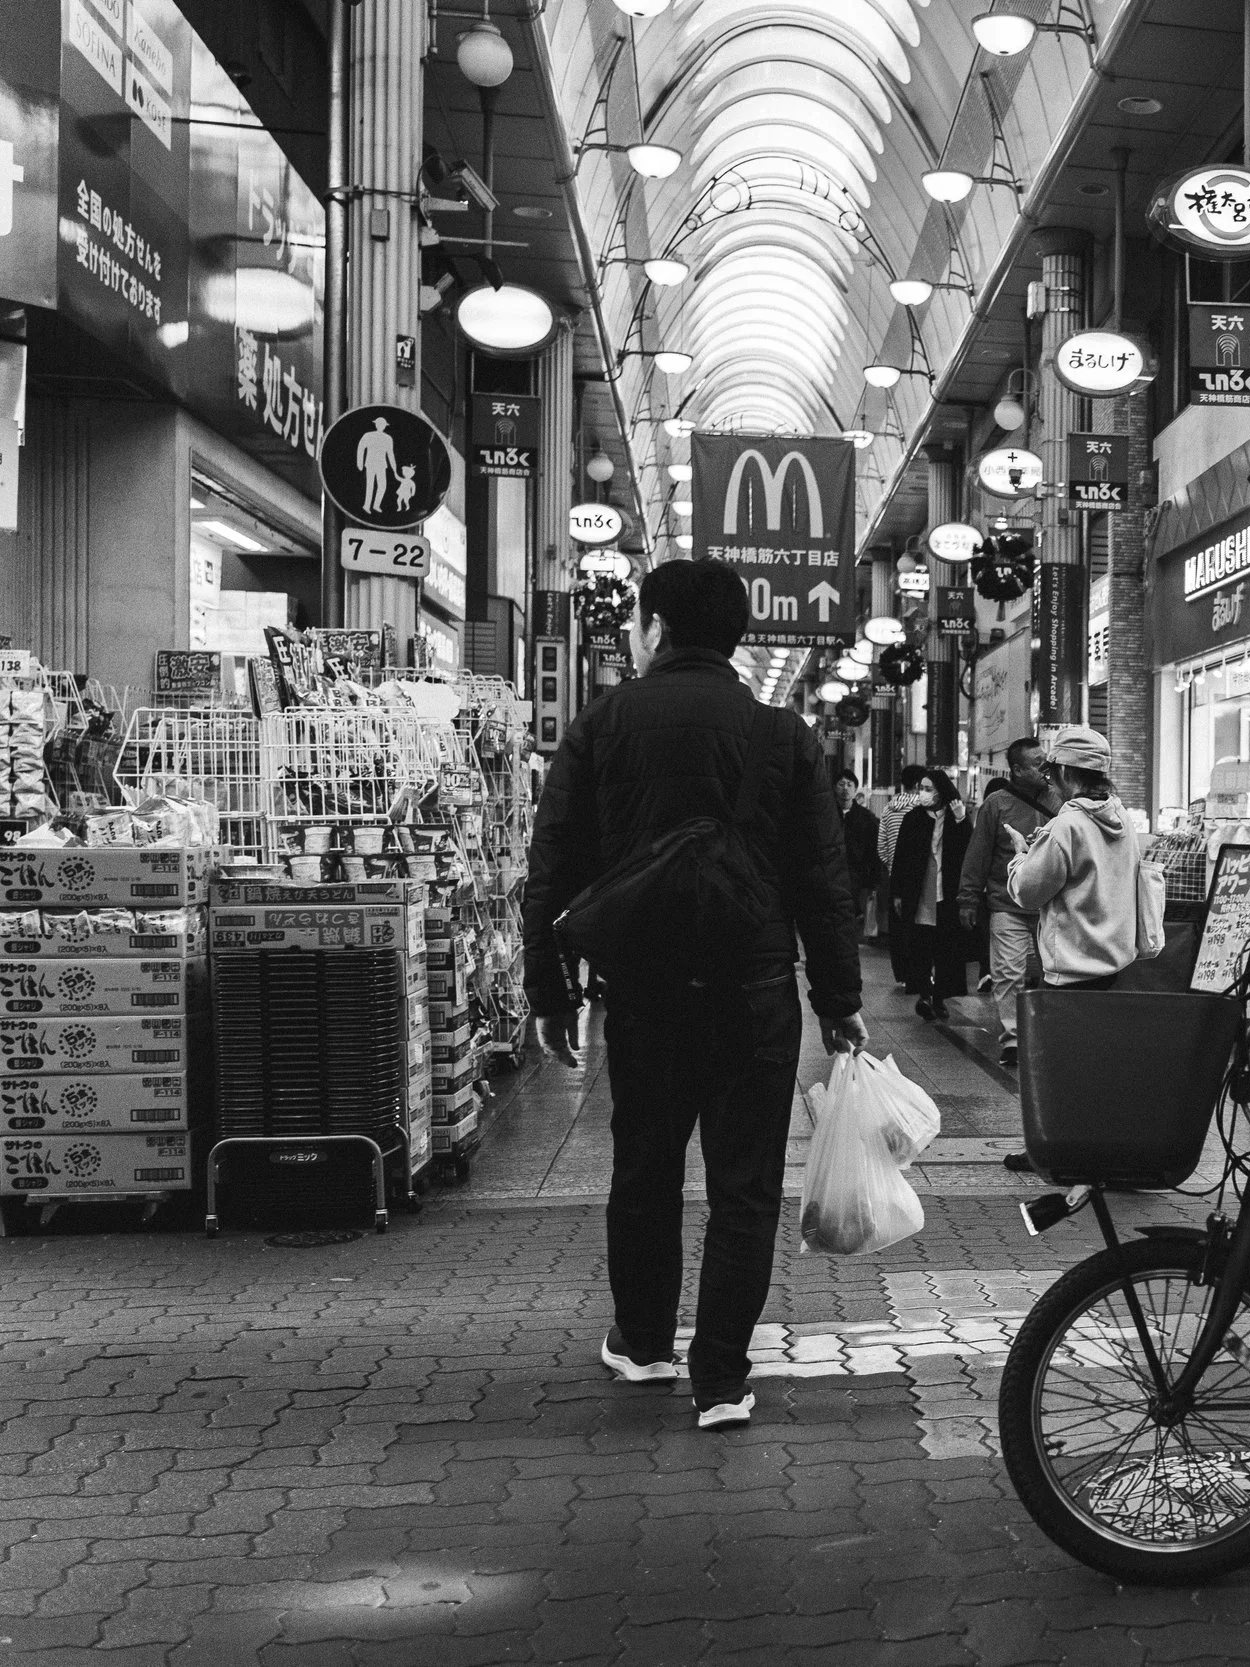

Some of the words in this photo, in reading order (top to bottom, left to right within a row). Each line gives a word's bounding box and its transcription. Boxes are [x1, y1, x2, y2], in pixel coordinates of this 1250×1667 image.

[77, 179, 162, 281] 全国の処方せんを
[76, 223, 162, 325] 受け付けております
[1211, 315, 1245, 331] 天六
[1069, 348, 1135, 372] まるしげ
[492, 402, 520, 417] 天六
[1086, 441, 1112, 454] 天六
[708, 546, 840, 567] 天神橋筋六丁目店
[1052, 566, 1060, 588] Let's
[741, 577, 798, 621] 0m
[947, 591, 964, 600] 天六
[1050, 590, 1060, 616] Enjoy
[1211, 582, 1245, 632] まるしげ
[1049, 618, 1060, 661] Shopping
[1, 660, 21, 671] 138
[1050, 664, 1058, 672] in
[1049, 674, 1058, 710] Arcade!
[4, 830, 21, 842] 98
[0, 862, 55, 888] ごはん
[1216, 873, 1248, 895] アワー
[269, 912, 360, 926] きつねうどん
[0, 973, 55, 998] ごはん
[0, 1030, 56, 1056] ごはん
[2, 1089, 58, 1115] ごはん
[5, 1149, 61, 1175] ごはん
